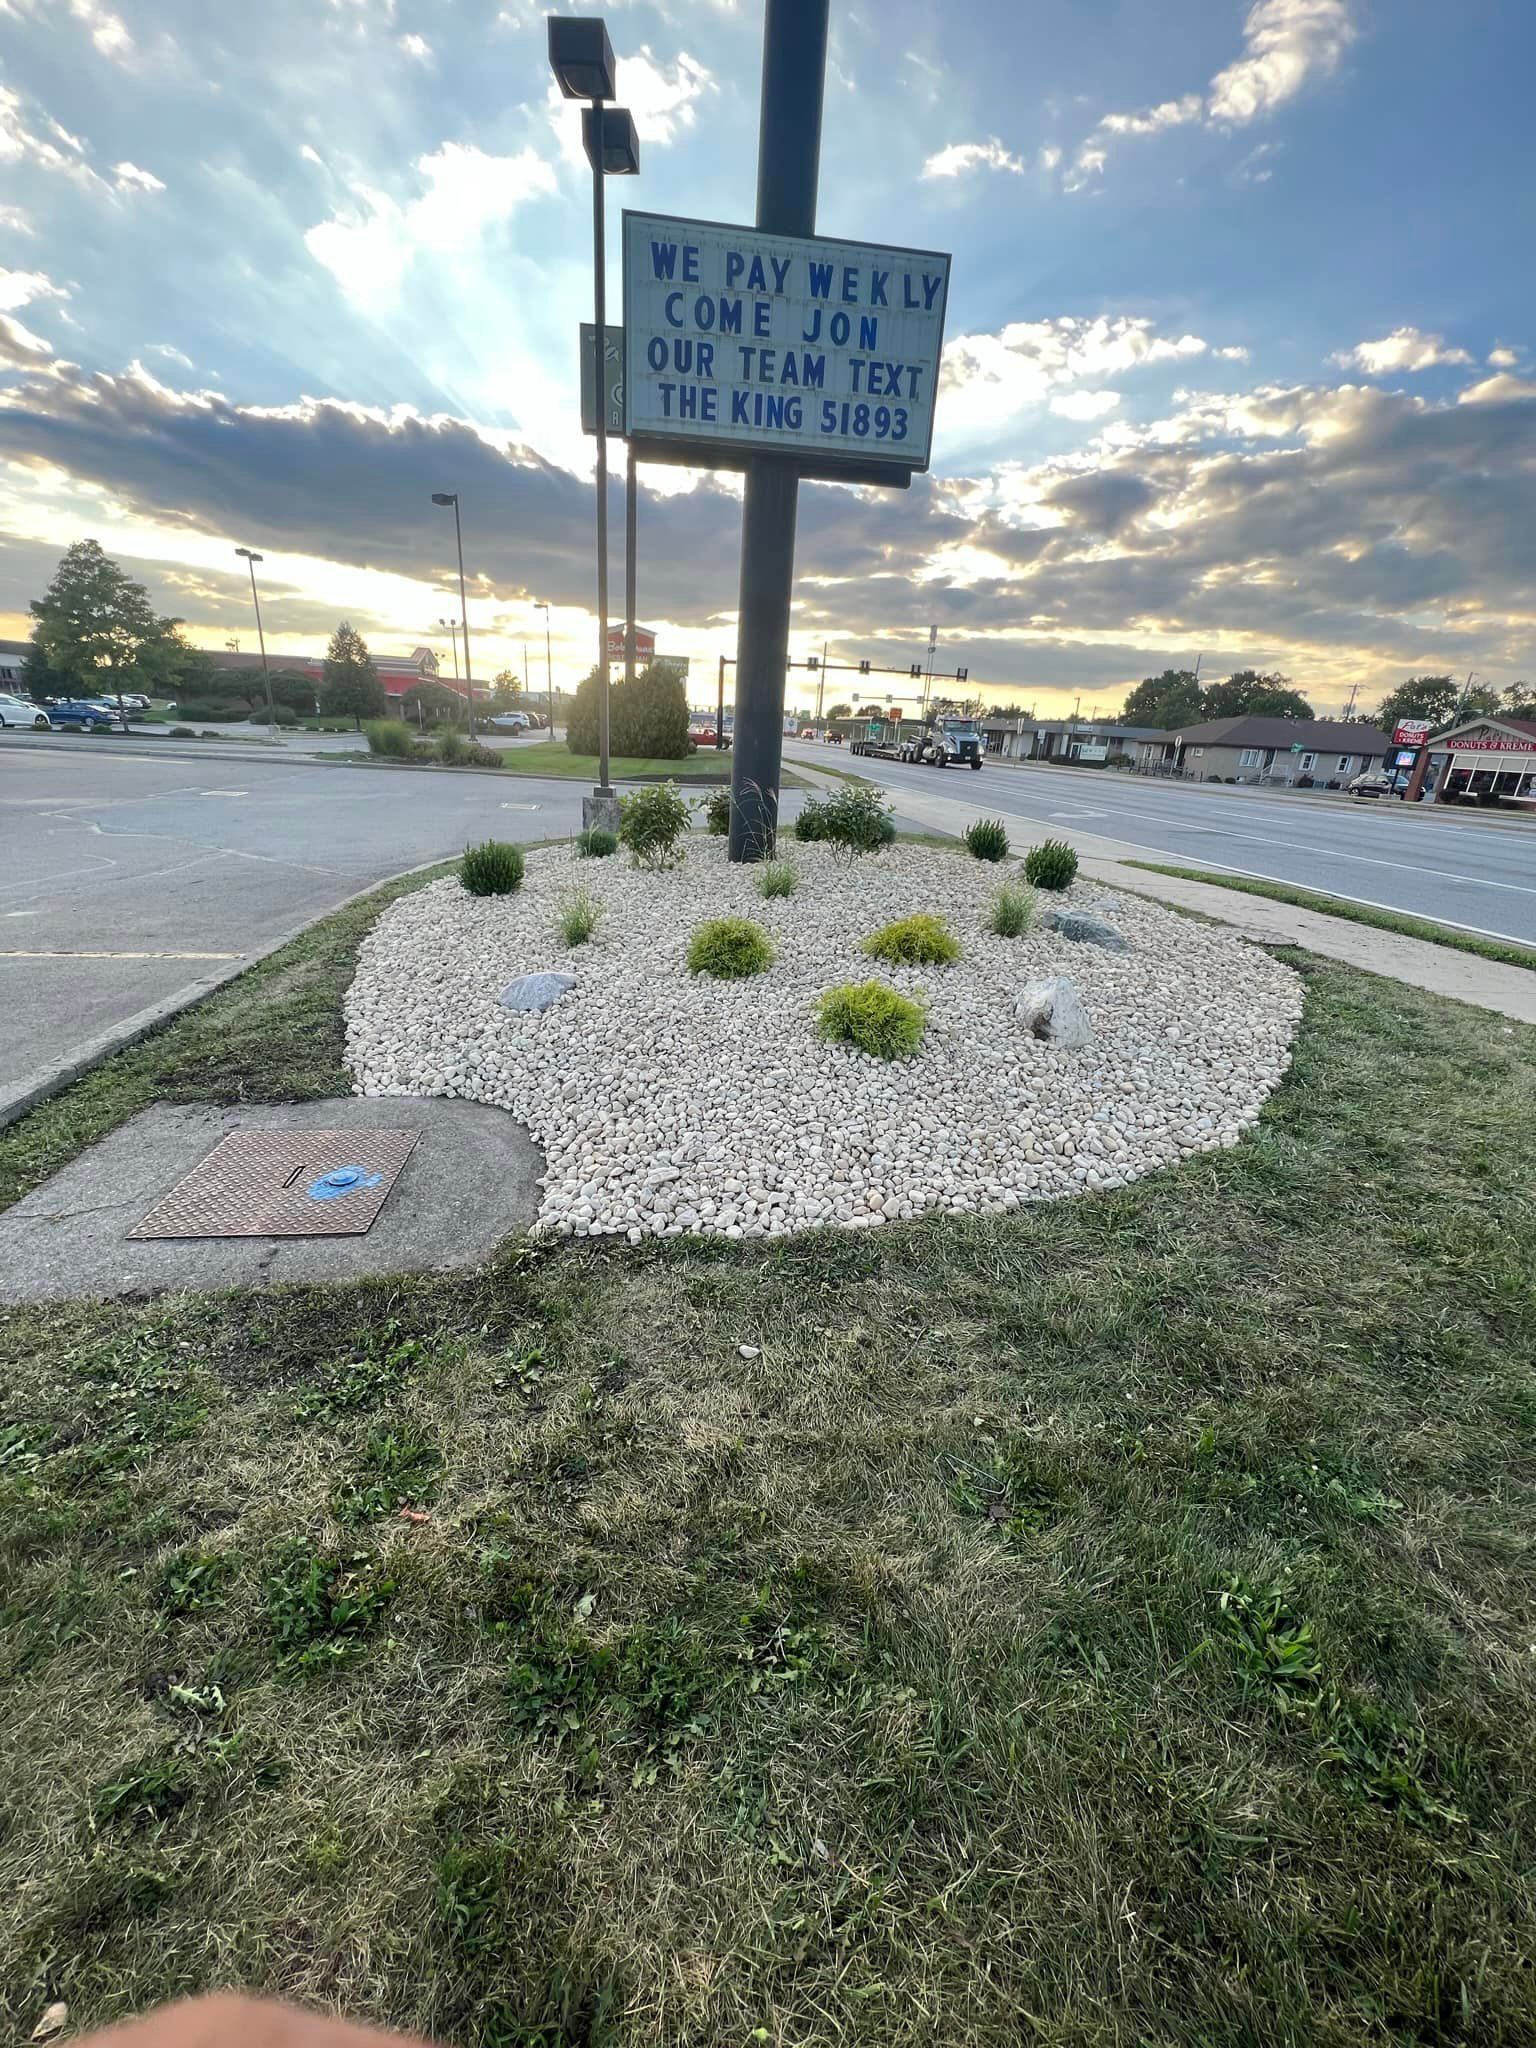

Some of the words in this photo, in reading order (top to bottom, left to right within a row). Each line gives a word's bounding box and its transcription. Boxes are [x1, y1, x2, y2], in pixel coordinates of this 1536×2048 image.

[651, 241, 699, 283] WE
[726, 252, 791, 294] PAY
[809, 262, 942, 311] WEKLY
[665, 292, 770, 337] COME
[803, 309, 878, 351] JON
[647, 336, 714, 378] OUR
[738, 346, 826, 389] TEAM
[848, 358, 923, 400] TEXT
[658, 383, 717, 422] THE
[731, 390, 803, 429] KING
[821, 401, 908, 441] 51893
[1399, 731, 1425, 739] DONUTS
[1450, 740, 1488, 750] DONUTS
[1489, 741, 1498, 750] &
[1500, 742, 1533, 751] KREME
